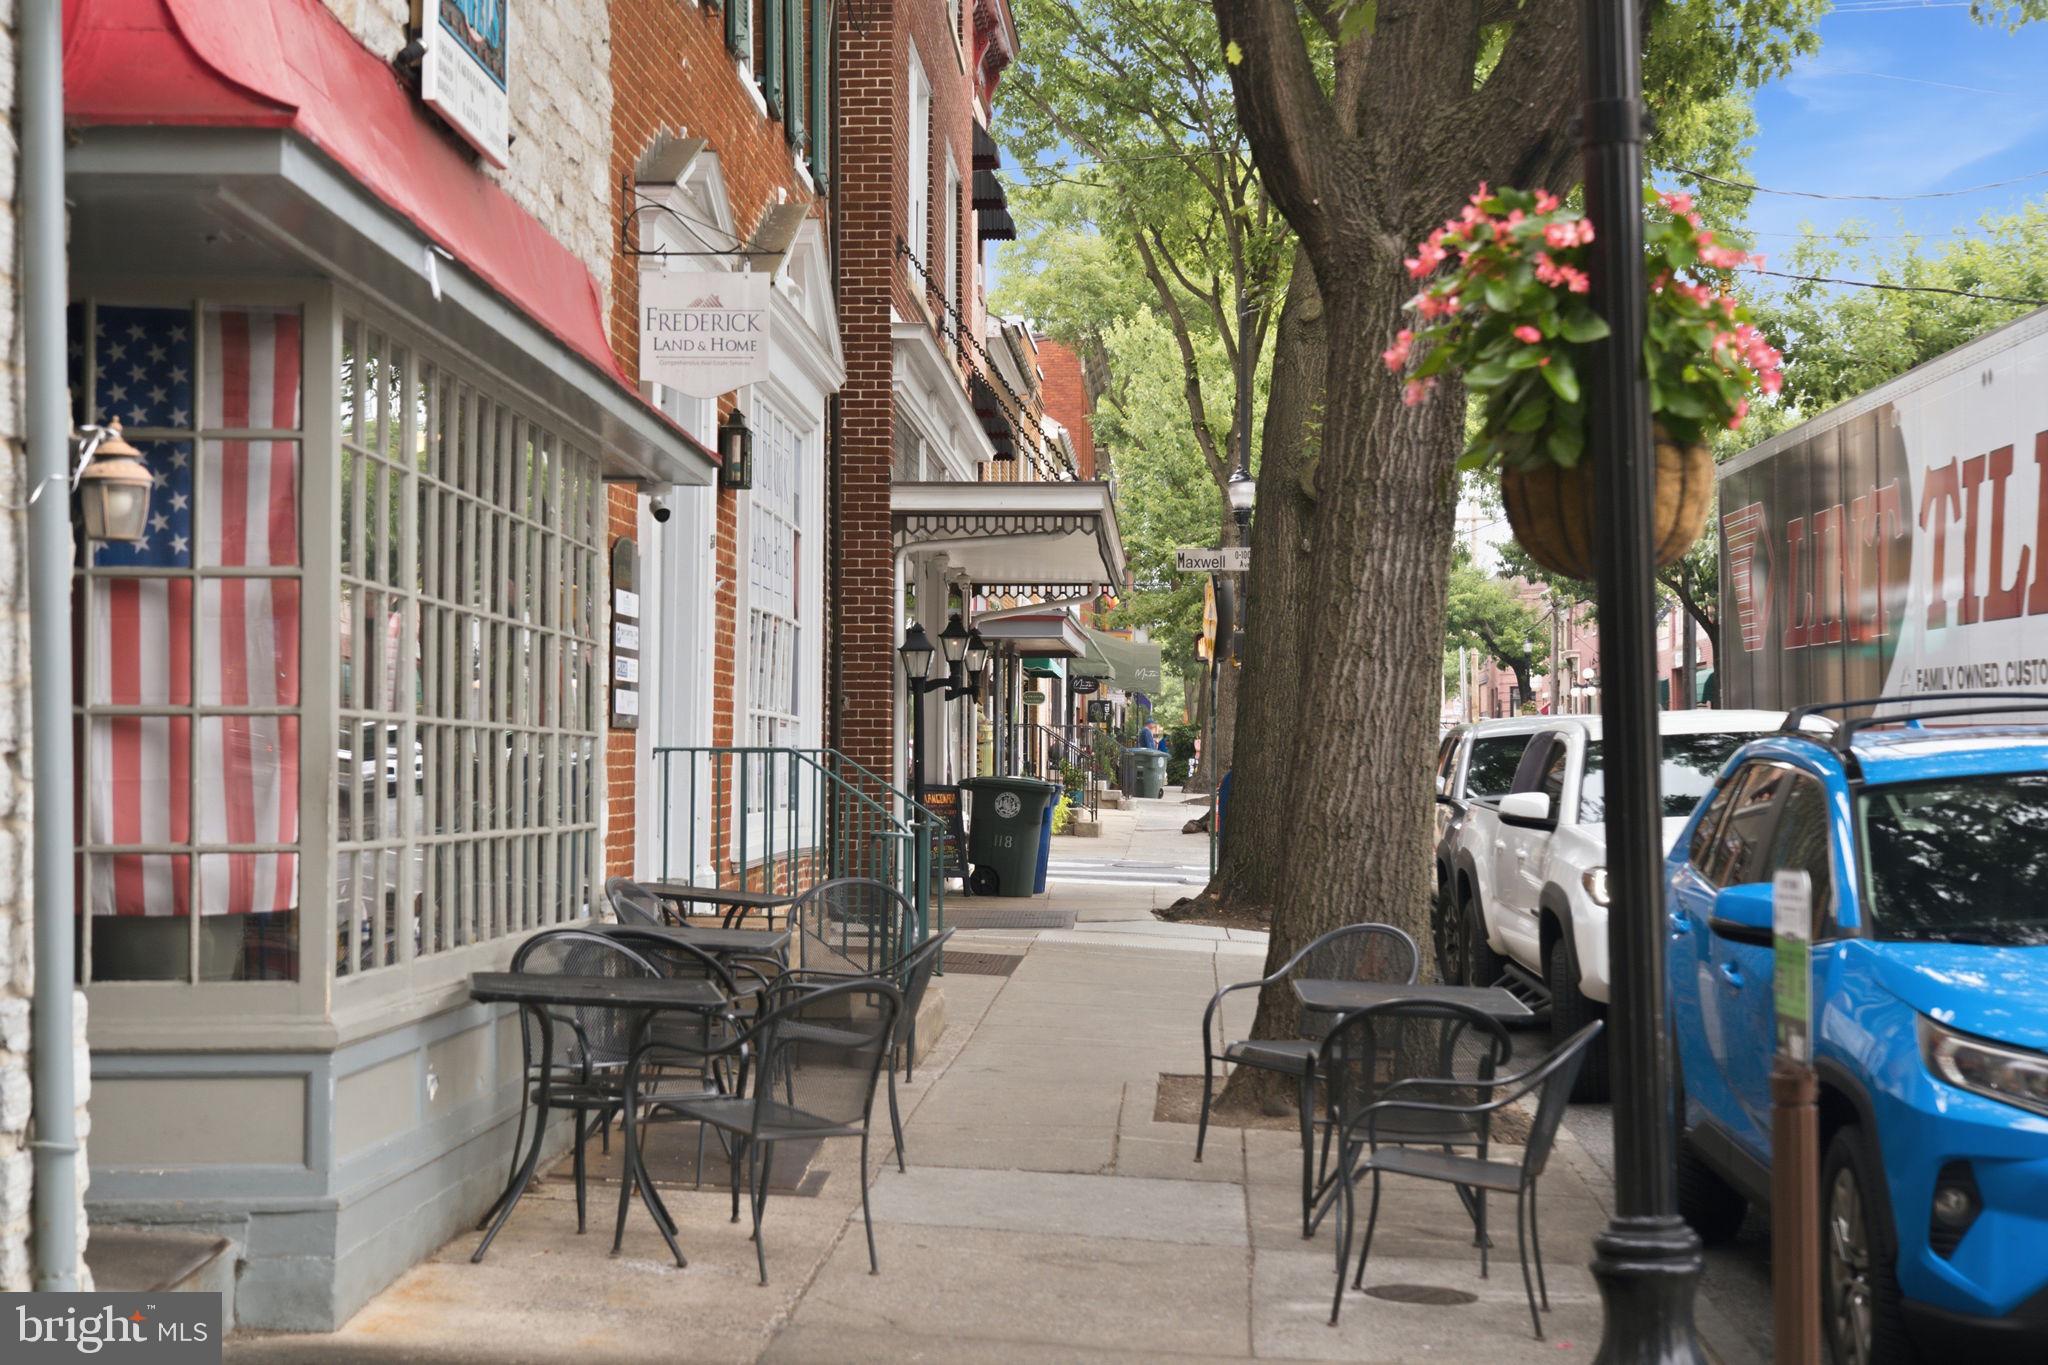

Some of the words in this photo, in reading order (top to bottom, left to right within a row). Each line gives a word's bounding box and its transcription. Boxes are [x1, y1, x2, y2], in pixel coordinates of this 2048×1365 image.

[646, 307, 762, 333] FREDERICK
[654, 337, 695, 352] LAND
[697, 341, 707, 351] &
[711, 337, 758, 352] HOME
[1177, 552, 1226, 569] Maxwell
[1916, 666, 1955, 692] FAMILY
[994, 834, 1013, 848] 118
